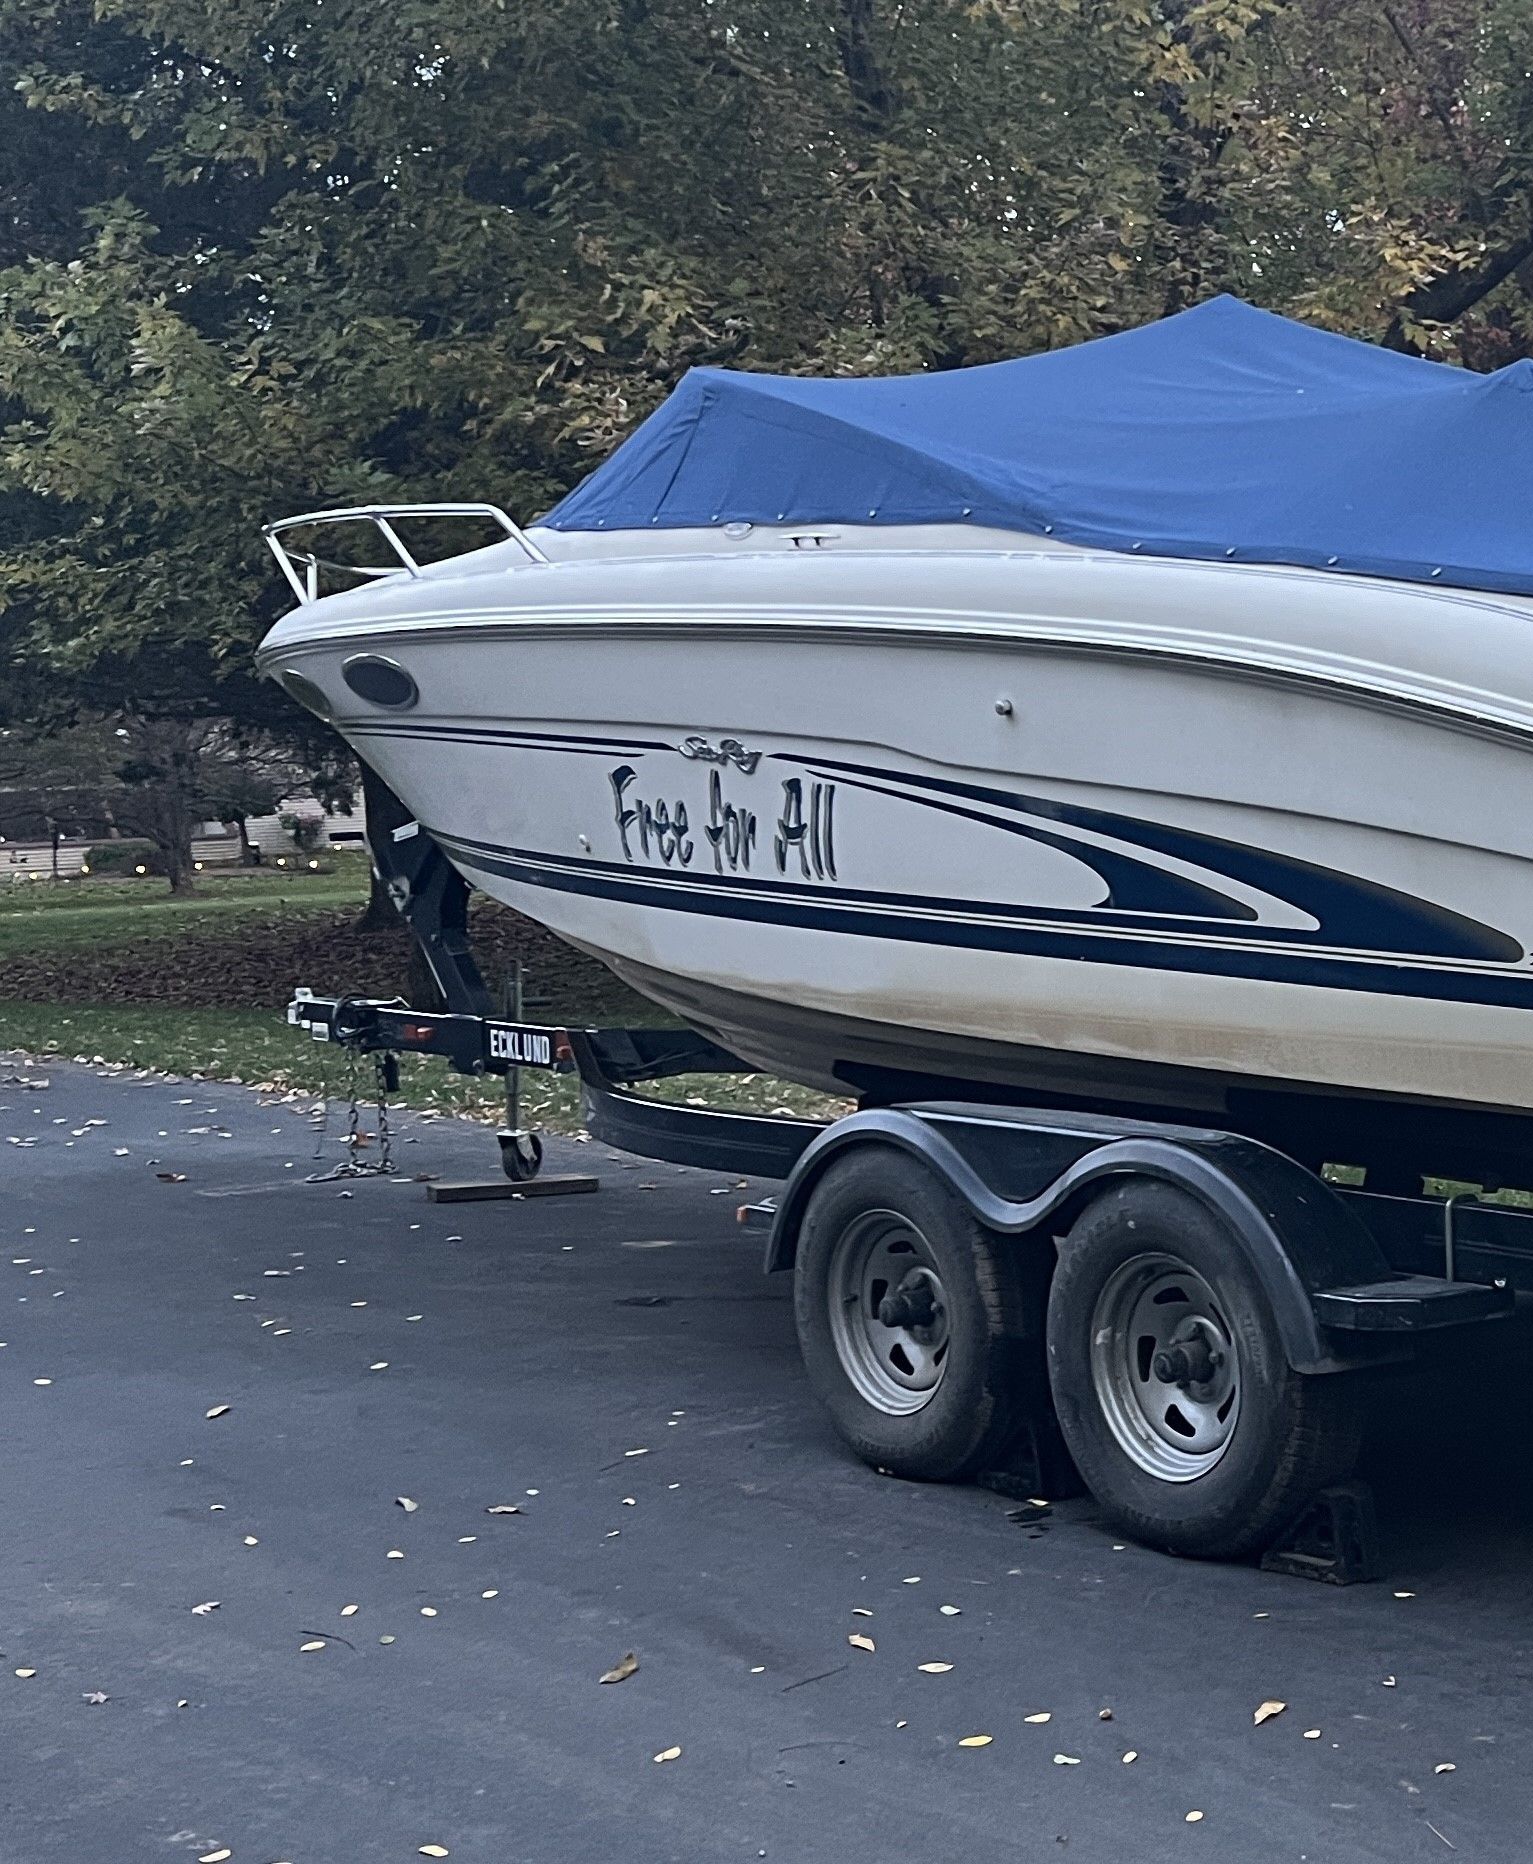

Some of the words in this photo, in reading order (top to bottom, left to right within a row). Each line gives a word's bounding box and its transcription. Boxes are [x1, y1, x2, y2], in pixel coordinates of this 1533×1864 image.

[608, 764, 694, 868] Free
[704, 768, 757, 876] for
[774, 777, 838, 882] All
[490, 1029, 550, 1065] ECKLUND
